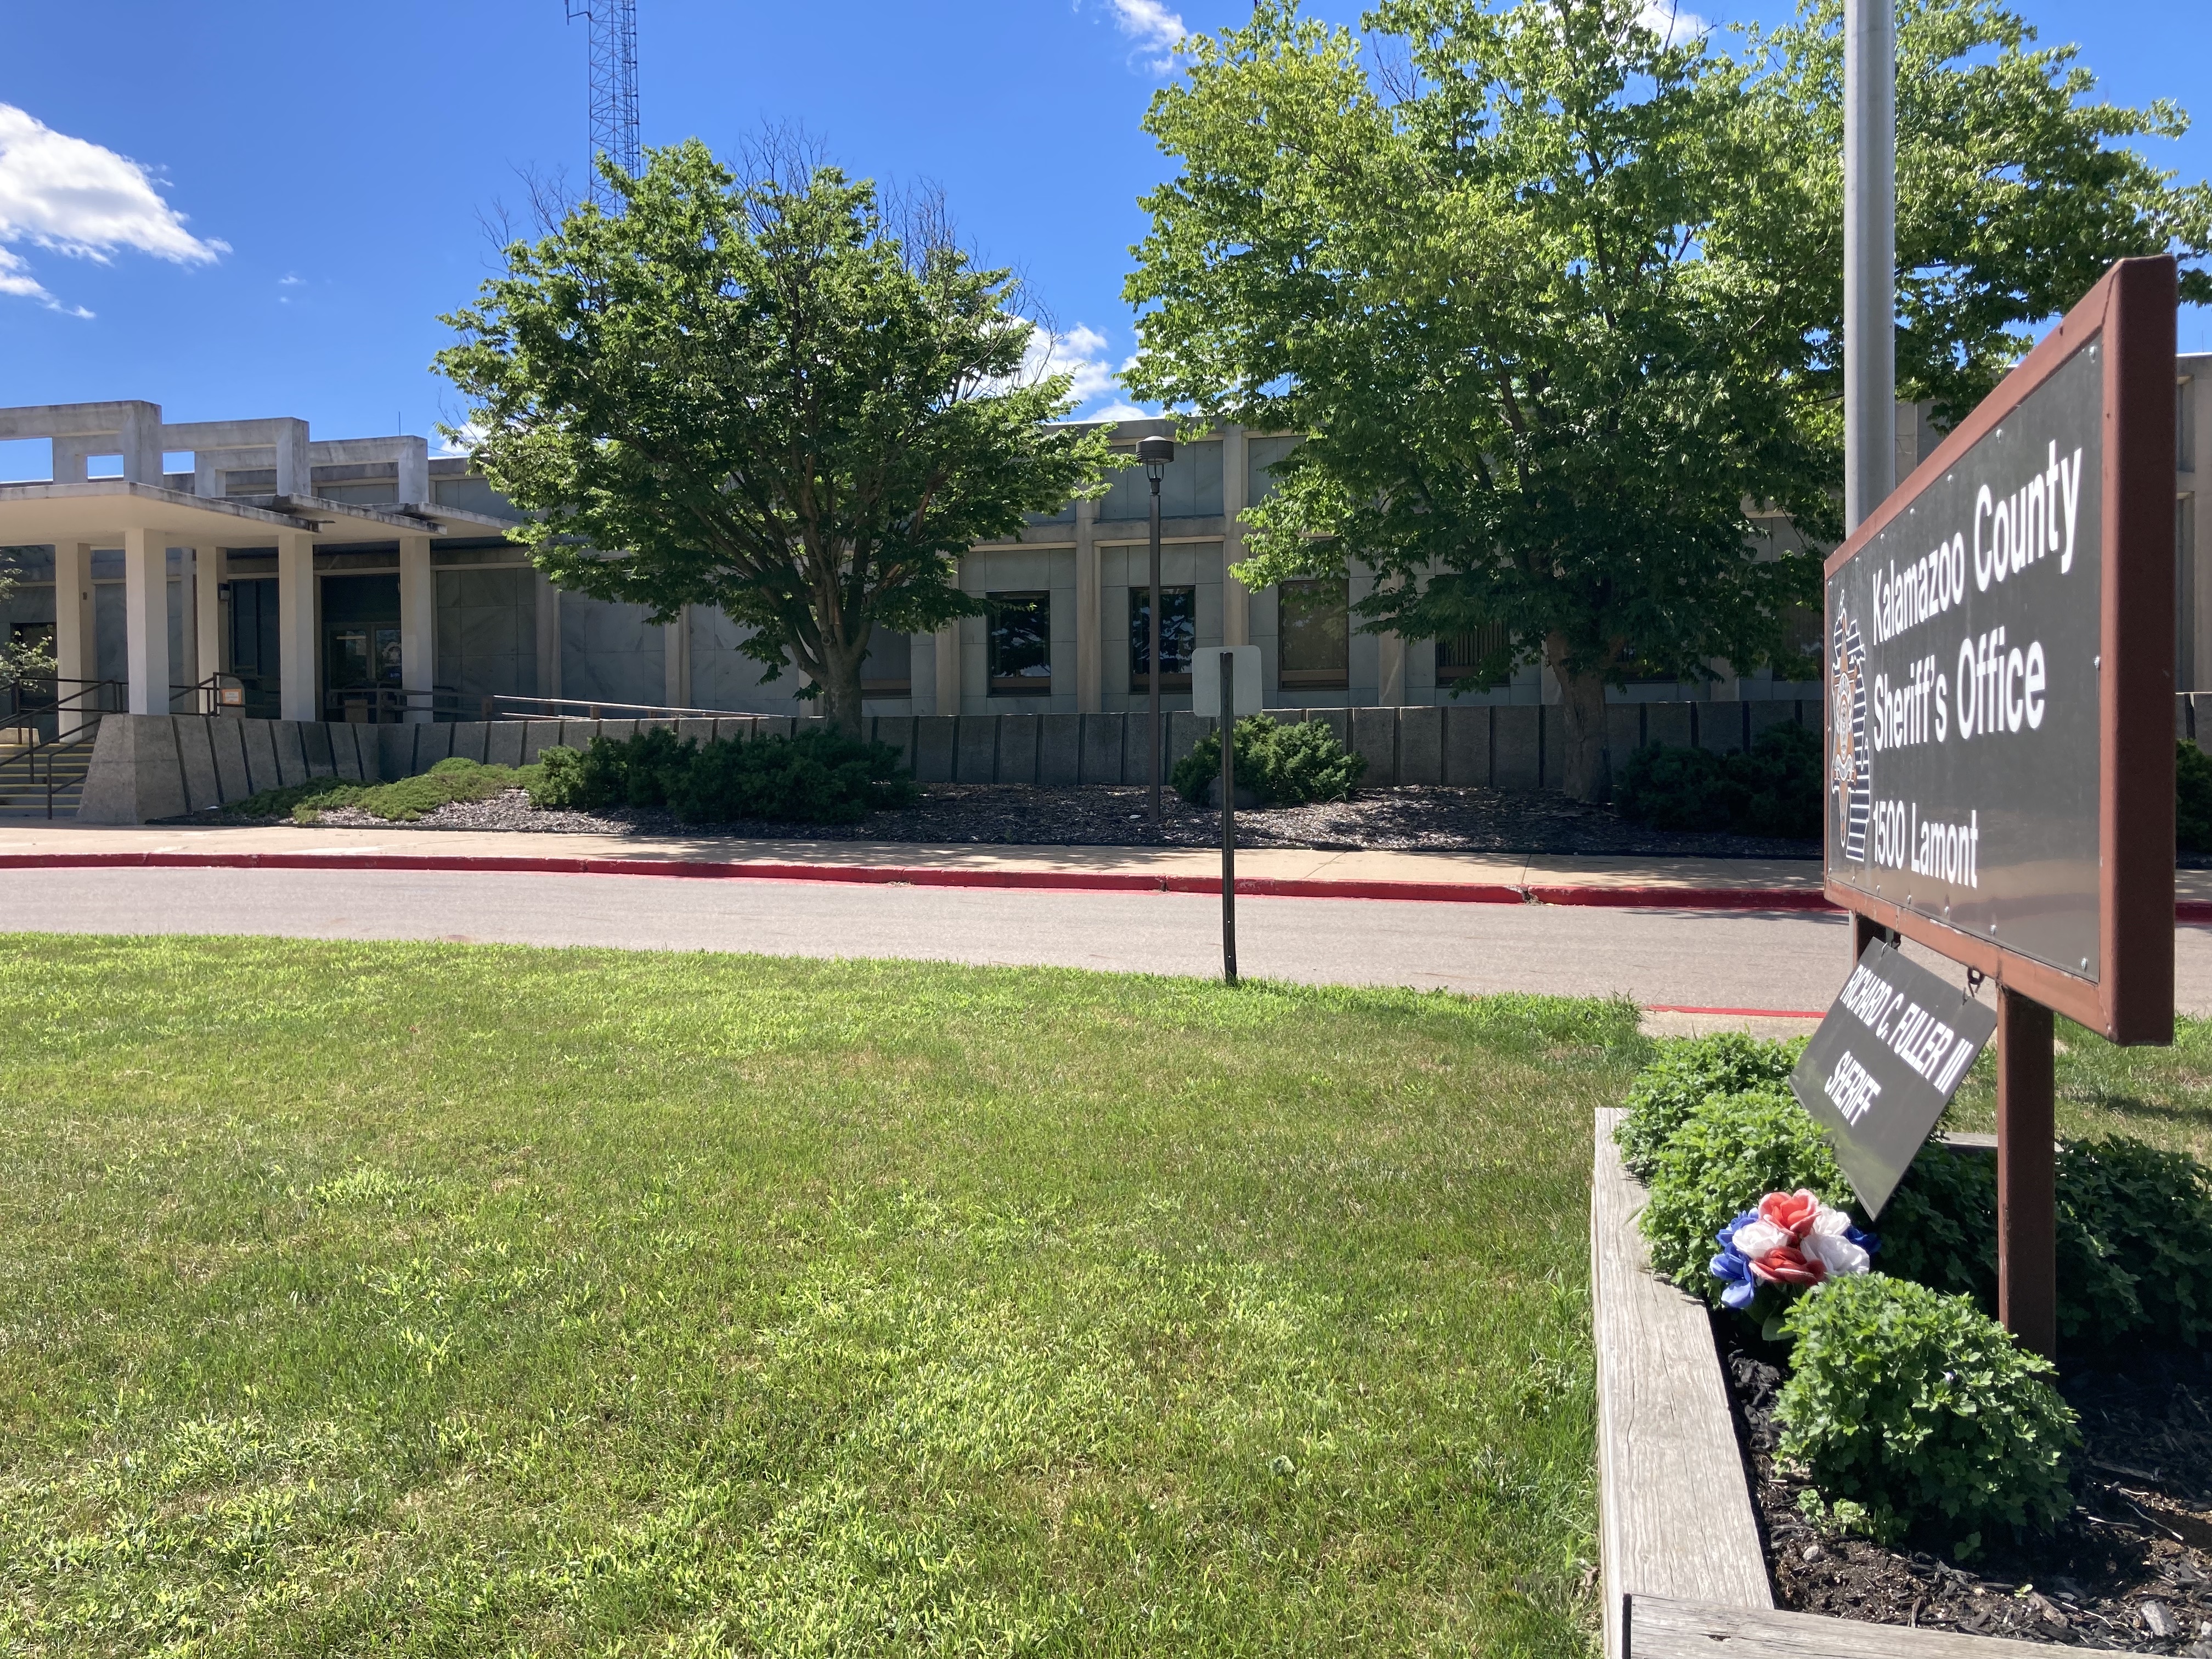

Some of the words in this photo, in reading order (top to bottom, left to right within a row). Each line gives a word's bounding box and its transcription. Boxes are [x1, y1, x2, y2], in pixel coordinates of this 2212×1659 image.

[1872, 531, 1966, 646] Kalamazoo
[1973, 438, 2083, 592] County
[1872, 653, 1948, 752] Sheriff's
[1956, 625, 2046, 740] Office
[1872, 799, 1906, 870] 1500
[1910, 802, 1978, 889] Lamont
[1839, 963, 1893, 1027] RICHARD
[1875, 992, 1905, 1040] C.
[1887, 1002, 1954, 1081] FULLER
[1933, 1037, 1974, 1096] III
[1824, 1050, 1882, 1127] SHERIFF
